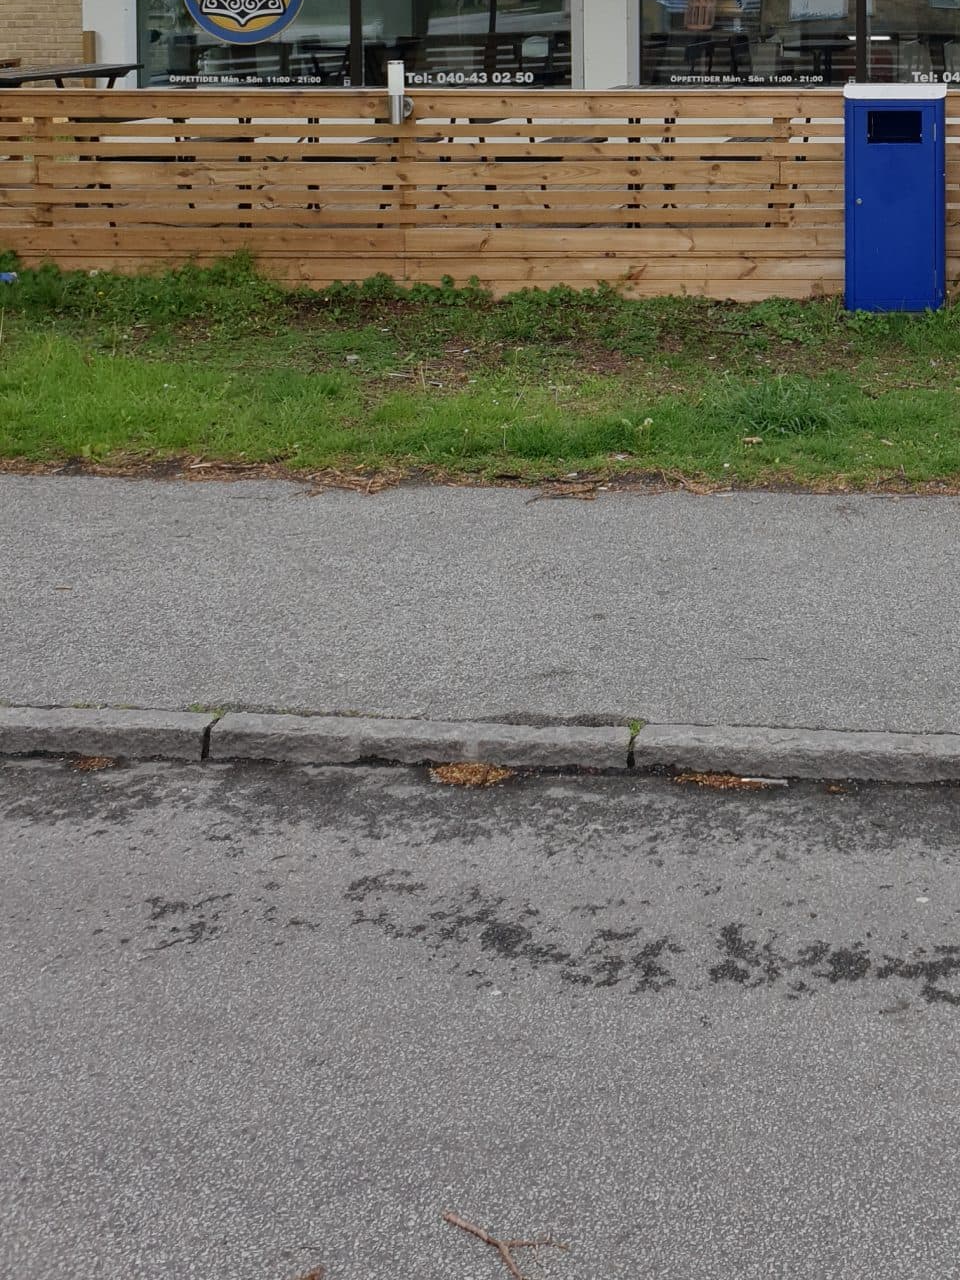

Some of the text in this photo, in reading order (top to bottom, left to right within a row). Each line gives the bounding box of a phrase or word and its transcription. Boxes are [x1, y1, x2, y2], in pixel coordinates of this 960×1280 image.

[169, 74, 219, 83] ÖPPETTIDER
[221, 74, 239, 83] Mån
[246, 74, 263, 83] Sön
[267, 74, 290, 83] 11:00
[298, 74, 322, 83] 21:00
[406, 72, 534, 84] Tel: 040-43 02 50
[670, 74, 720, 83] ÖPPETTIDER
[722, 74, 741, 83] Mån
[748, 74, 765, 83] Sön
[769, 74, 793, 83] 11:00
[800, 74, 824, 83] 21:00
[911, 71, 938, 83] Tel:
